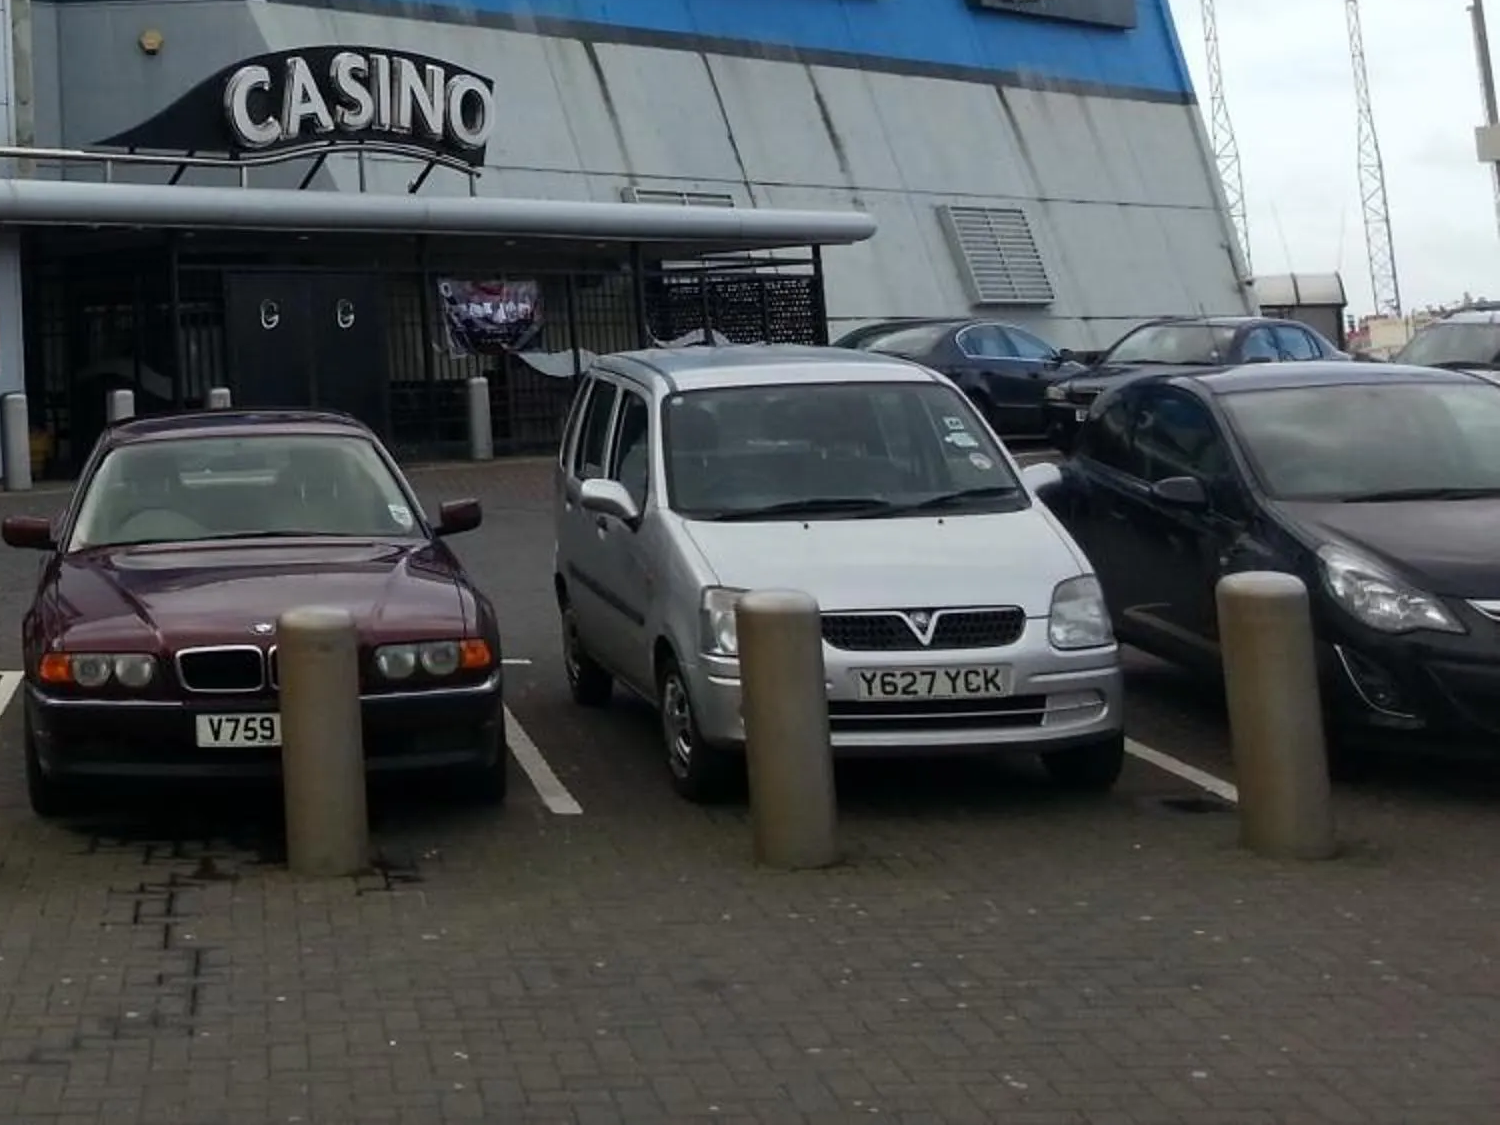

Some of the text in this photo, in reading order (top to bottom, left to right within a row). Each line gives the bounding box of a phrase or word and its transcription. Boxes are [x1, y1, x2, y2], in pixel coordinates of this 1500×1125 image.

[223, 51, 495, 149] CASINO
[859, 668, 1002, 697] Y627 YCK
[208, 716, 275, 742] V759
